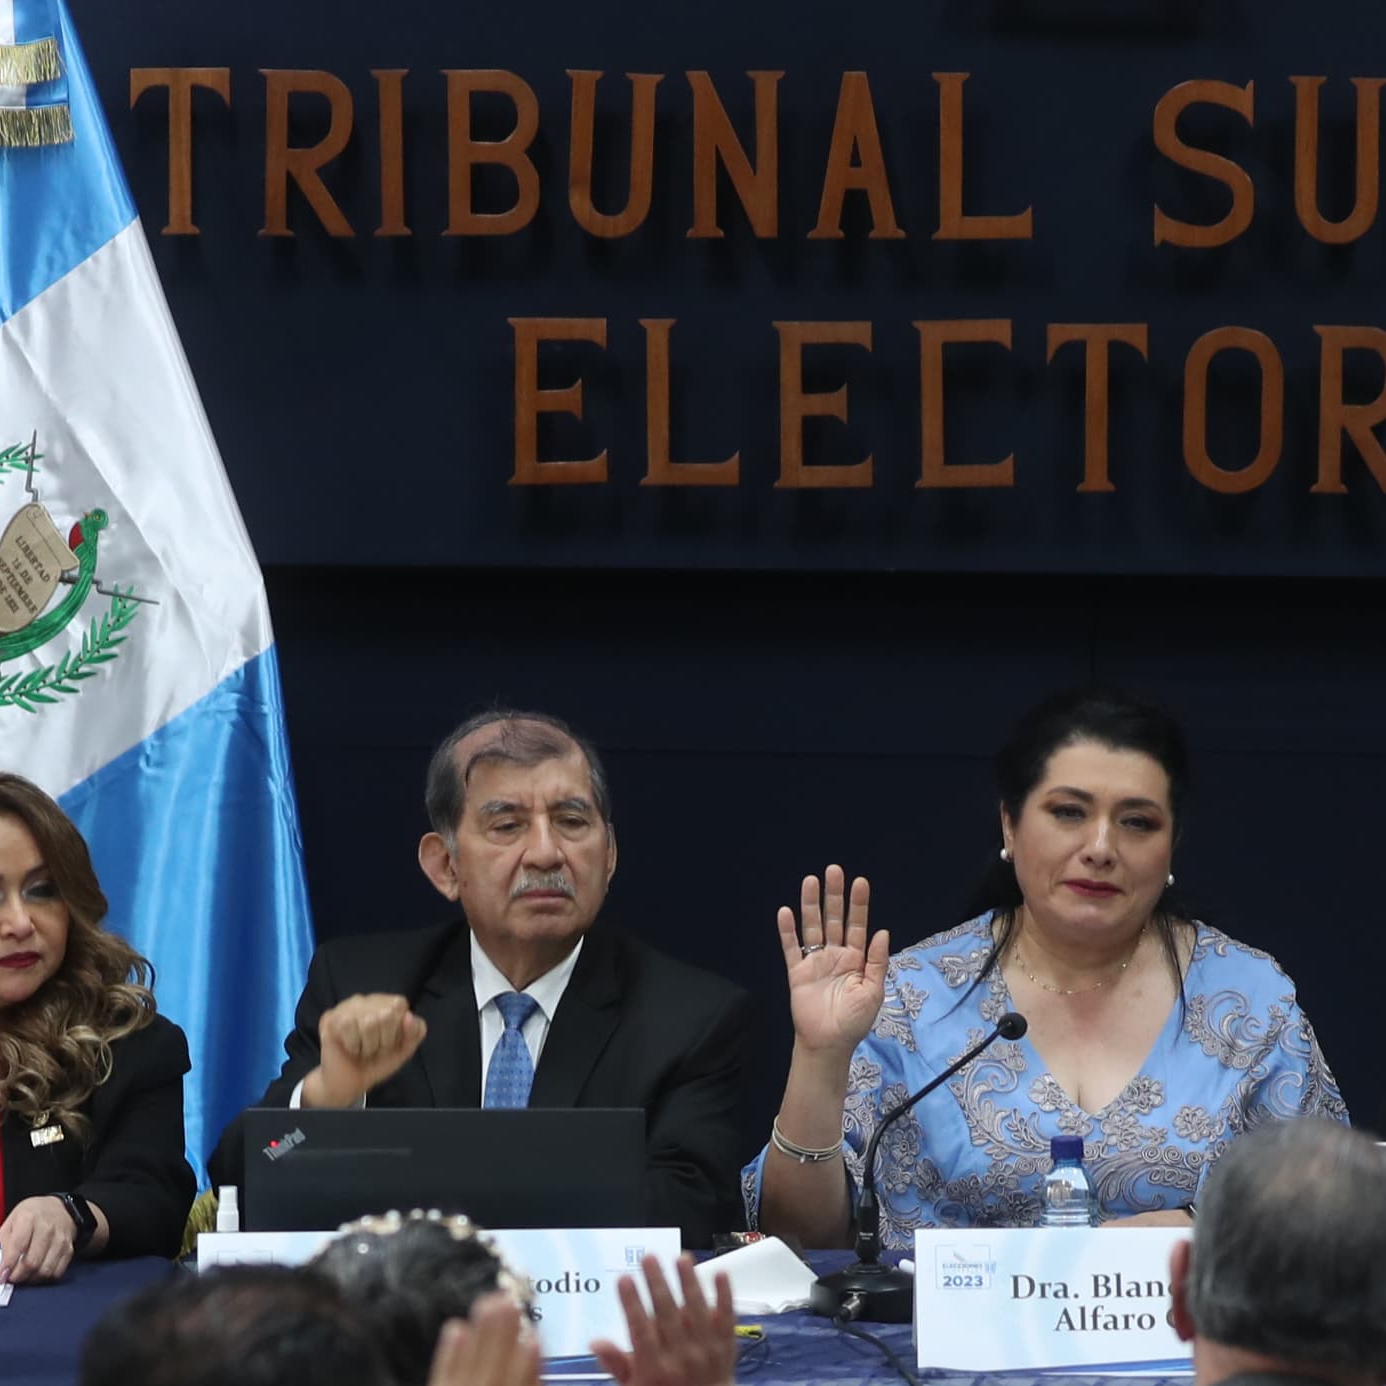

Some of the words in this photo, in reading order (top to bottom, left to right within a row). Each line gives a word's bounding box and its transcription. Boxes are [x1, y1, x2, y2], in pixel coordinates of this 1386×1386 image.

[129, 67, 1033, 239] TRIBUNAL
[15, 535, 51, 583] LIBERTAD
[943, 1275, 983, 1287] 2023
[1011, 1274, 1079, 1299] Dra.
[1091, 1272, 1173, 1298] Blan
[1053, 1305, 1156, 1331] Alfaro
